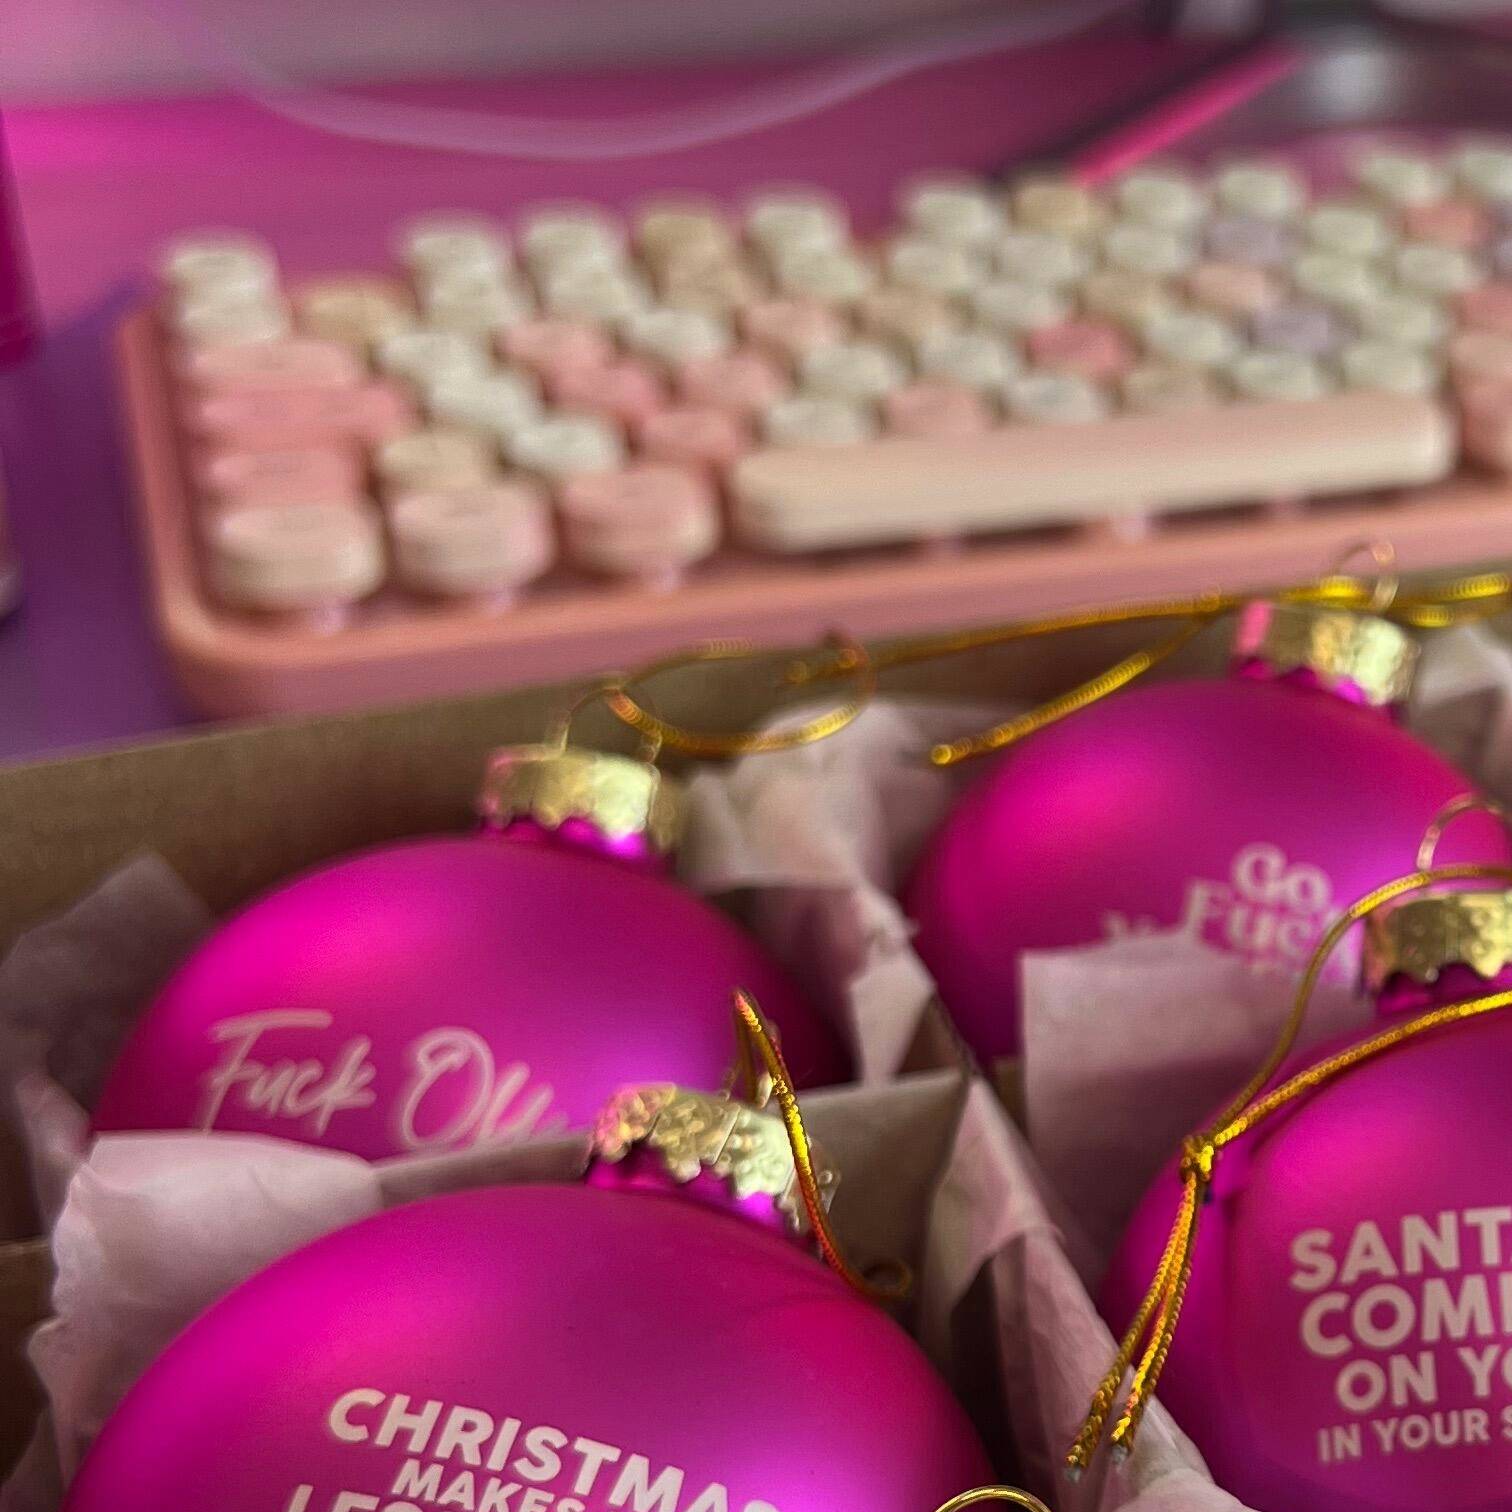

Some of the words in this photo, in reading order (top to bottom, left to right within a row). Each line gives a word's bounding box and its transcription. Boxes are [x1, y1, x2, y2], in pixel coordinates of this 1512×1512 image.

[1335, 1350, 1439, 1412] ON
[1317, 1422, 1363, 1464] IN
[1373, 1408, 1490, 1454] YOUR
